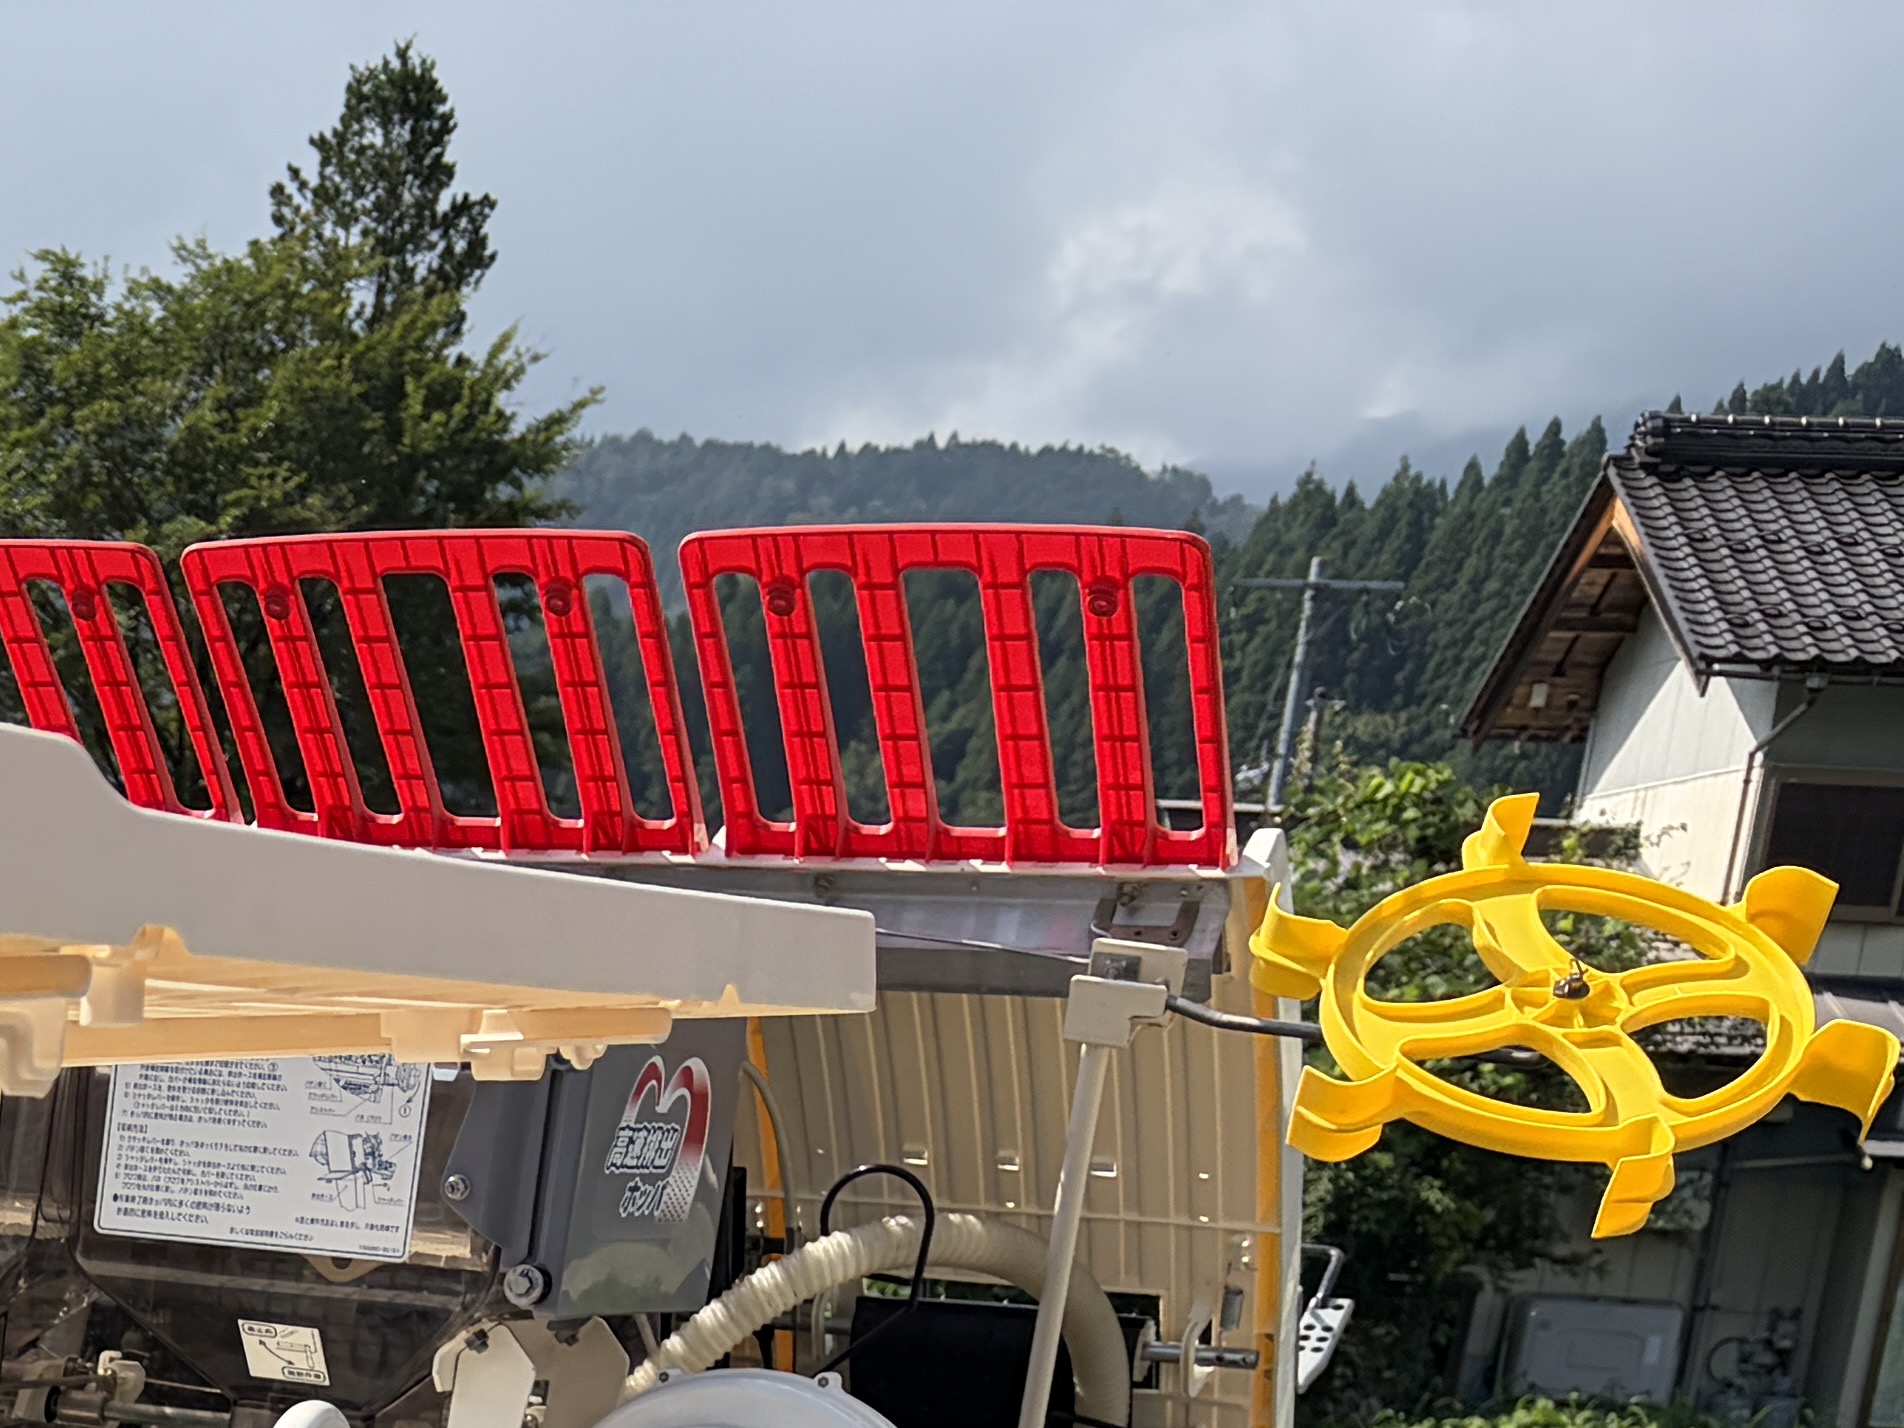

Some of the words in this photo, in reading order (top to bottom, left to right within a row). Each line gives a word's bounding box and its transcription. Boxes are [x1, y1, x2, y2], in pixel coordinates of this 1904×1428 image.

[605, 1122, 680, 1173] 高速排出
[619, 1177, 669, 1216] ホッパ
